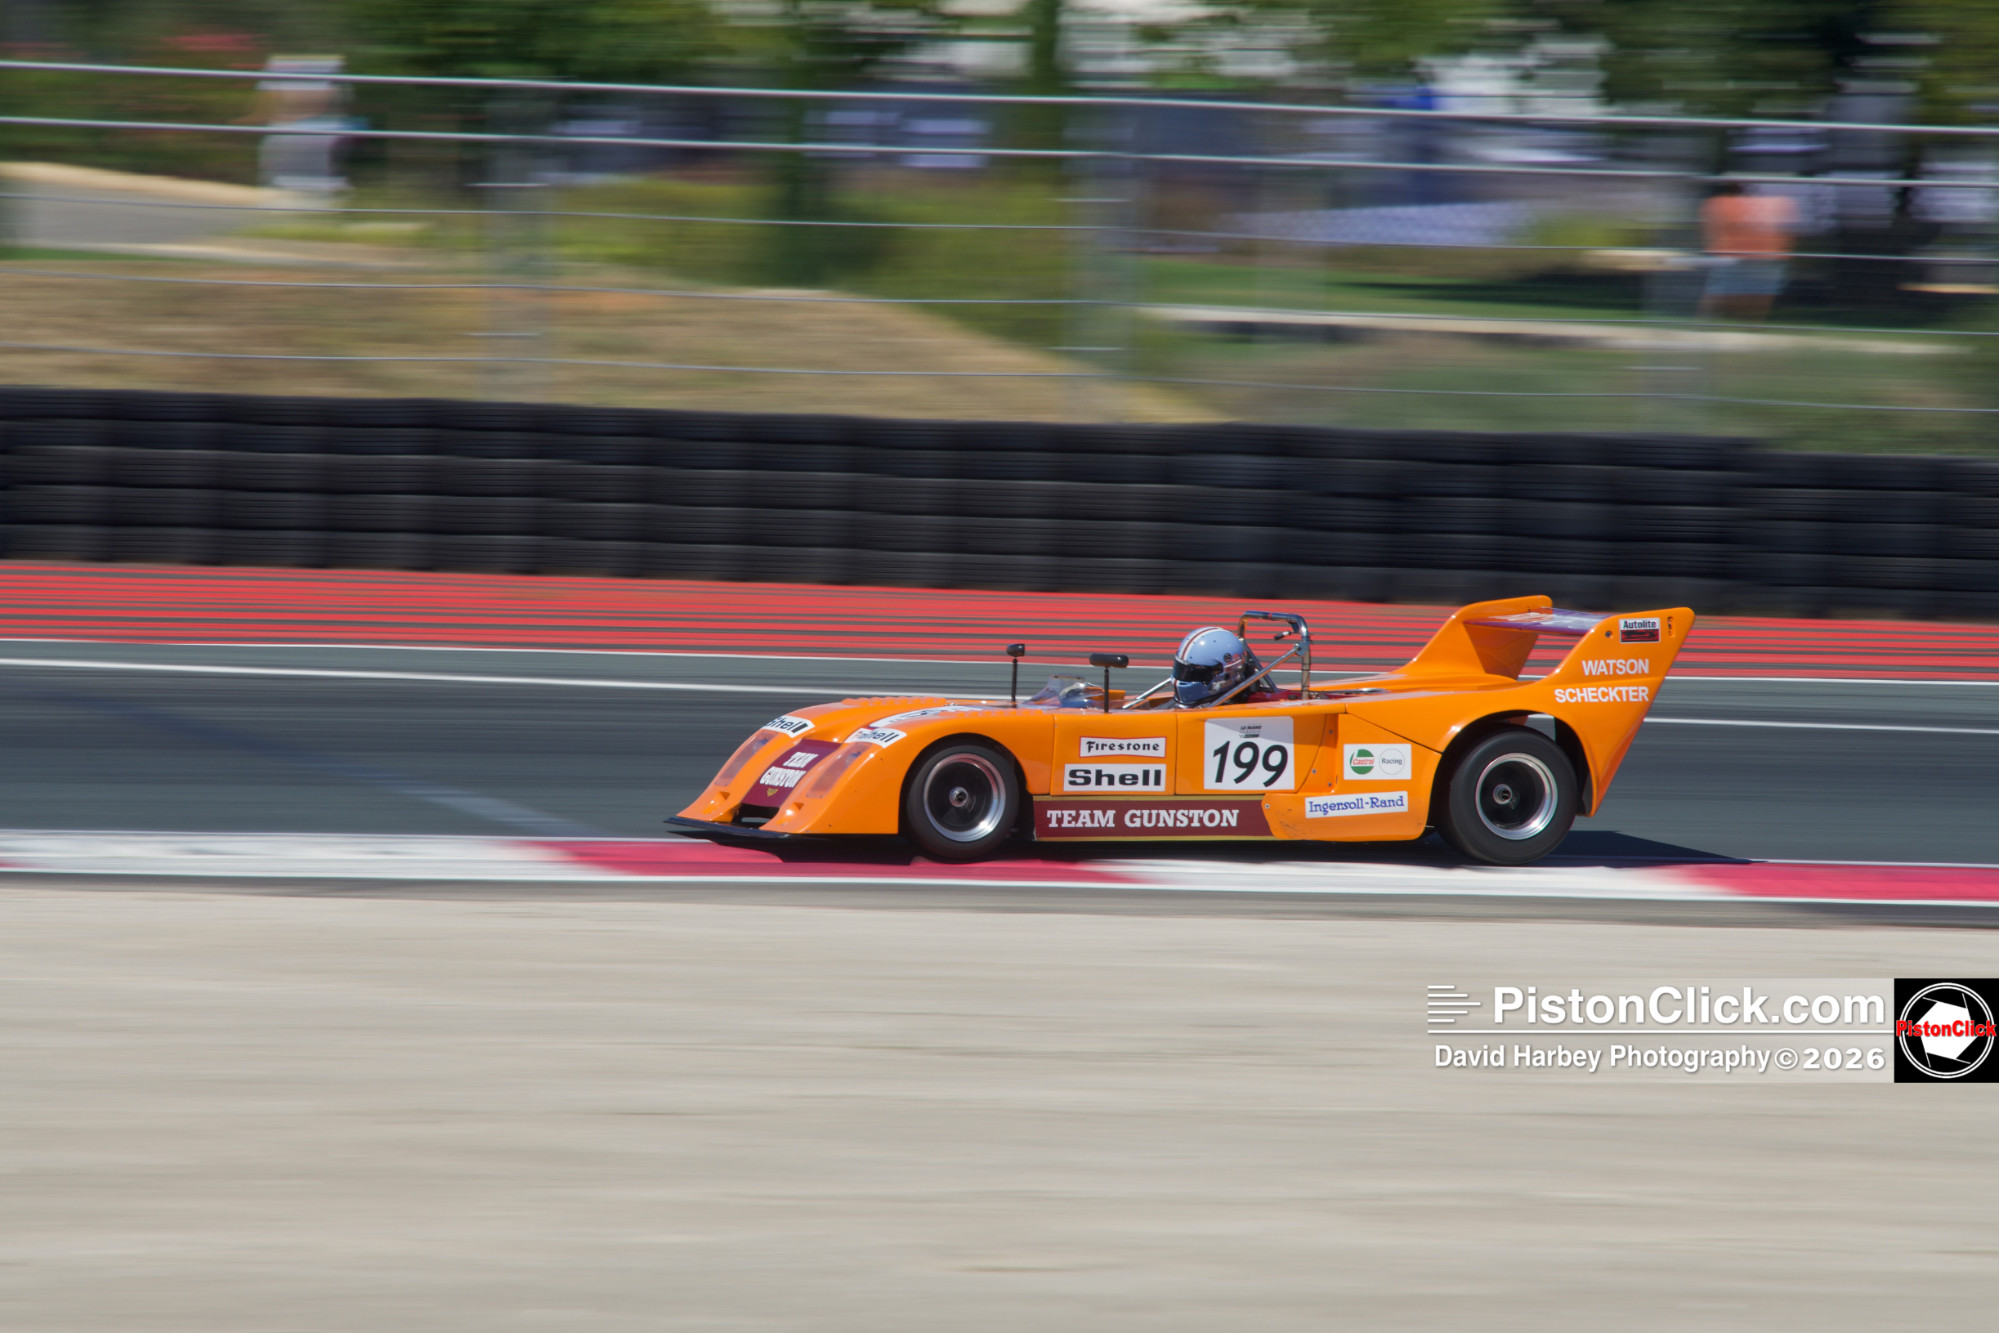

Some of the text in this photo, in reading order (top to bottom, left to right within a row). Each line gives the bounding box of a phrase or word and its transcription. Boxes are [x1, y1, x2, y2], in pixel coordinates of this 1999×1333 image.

[1623, 620, 1657, 629] Autolite
[1582, 659, 1649, 675] WATSON
[1554, 687, 1649, 703] SCHECKTER
[1086, 740, 1160, 752] Firestone
[1212, 740, 1288, 788] 199
[1381, 757, 1402, 765] Racing
[1068, 769, 1162, 786] Shell
[1309, 796, 1405, 815] Ingersoll-Rand
[1047, 809, 1240, 828] TEAM GUNSTON
